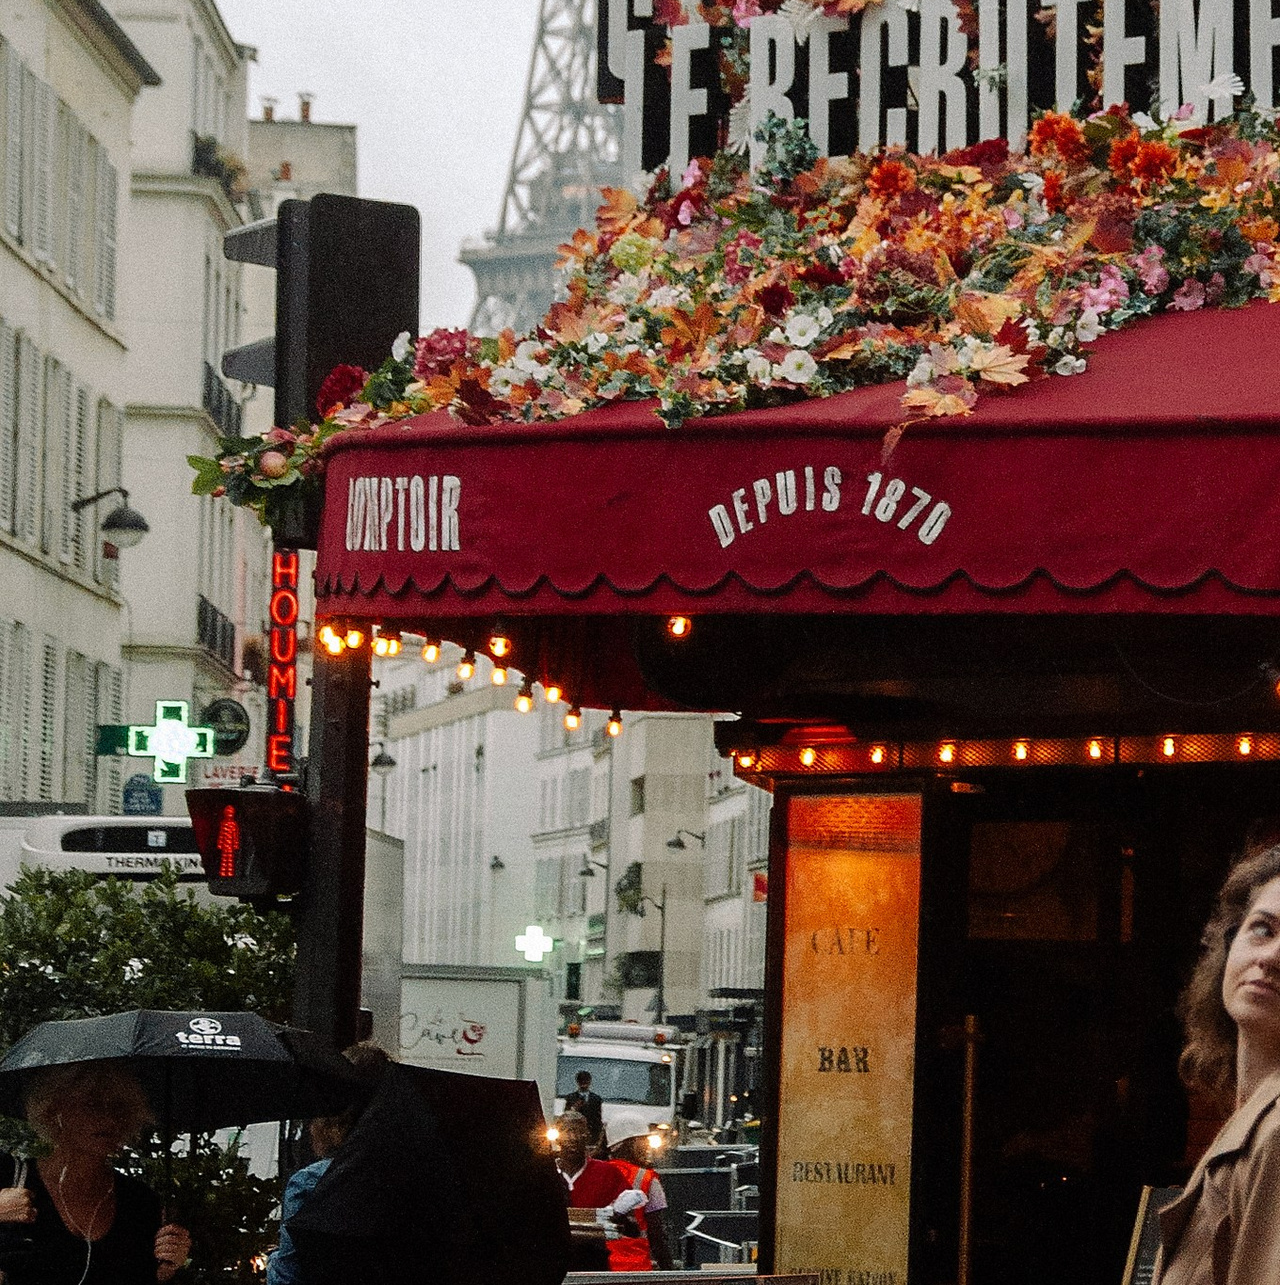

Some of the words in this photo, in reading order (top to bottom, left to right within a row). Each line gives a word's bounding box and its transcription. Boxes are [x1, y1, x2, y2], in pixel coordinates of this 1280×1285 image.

[709, 466, 842, 549] DEPUIS
[861, 471, 952, 546] 1870
[267, 552, 298, 772] HOUMIE
[106, 857, 170, 867] THERM
[174, 857, 200, 867] KIN
[175, 1032, 241, 1046] terra
[818, 1046, 870, 1073] BAR
